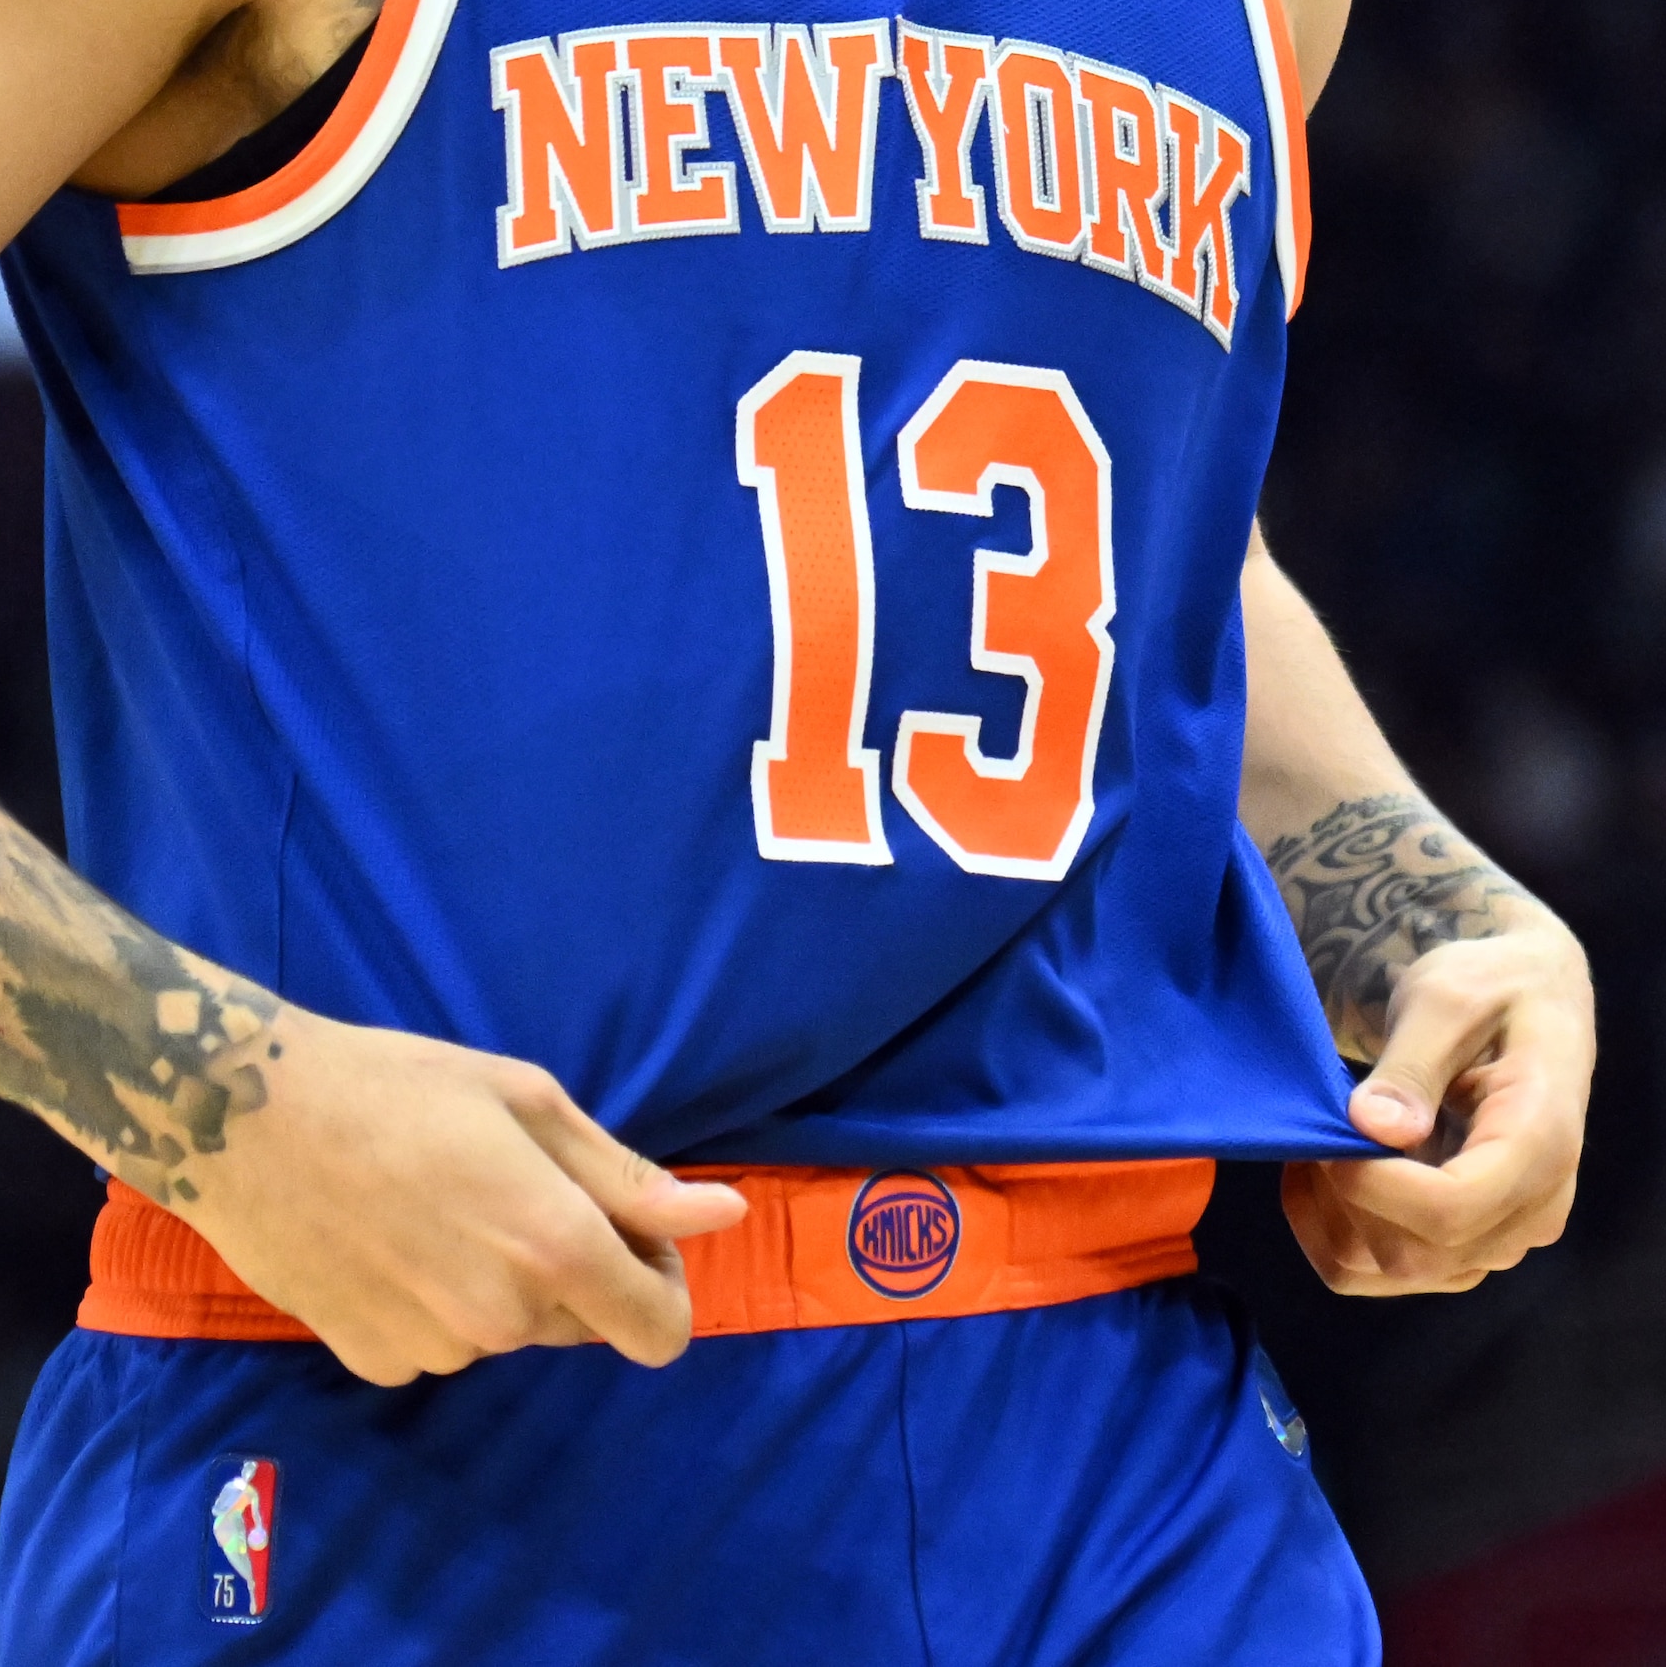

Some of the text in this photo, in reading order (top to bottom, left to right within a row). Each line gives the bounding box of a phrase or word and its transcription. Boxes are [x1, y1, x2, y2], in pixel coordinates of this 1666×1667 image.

[490, 15, 1251, 352] NEW YORK
[736, 350, 1117, 881] 13
[862, 1204, 947, 1263] KNICKS
[213, 1573, 235, 1608] 75
